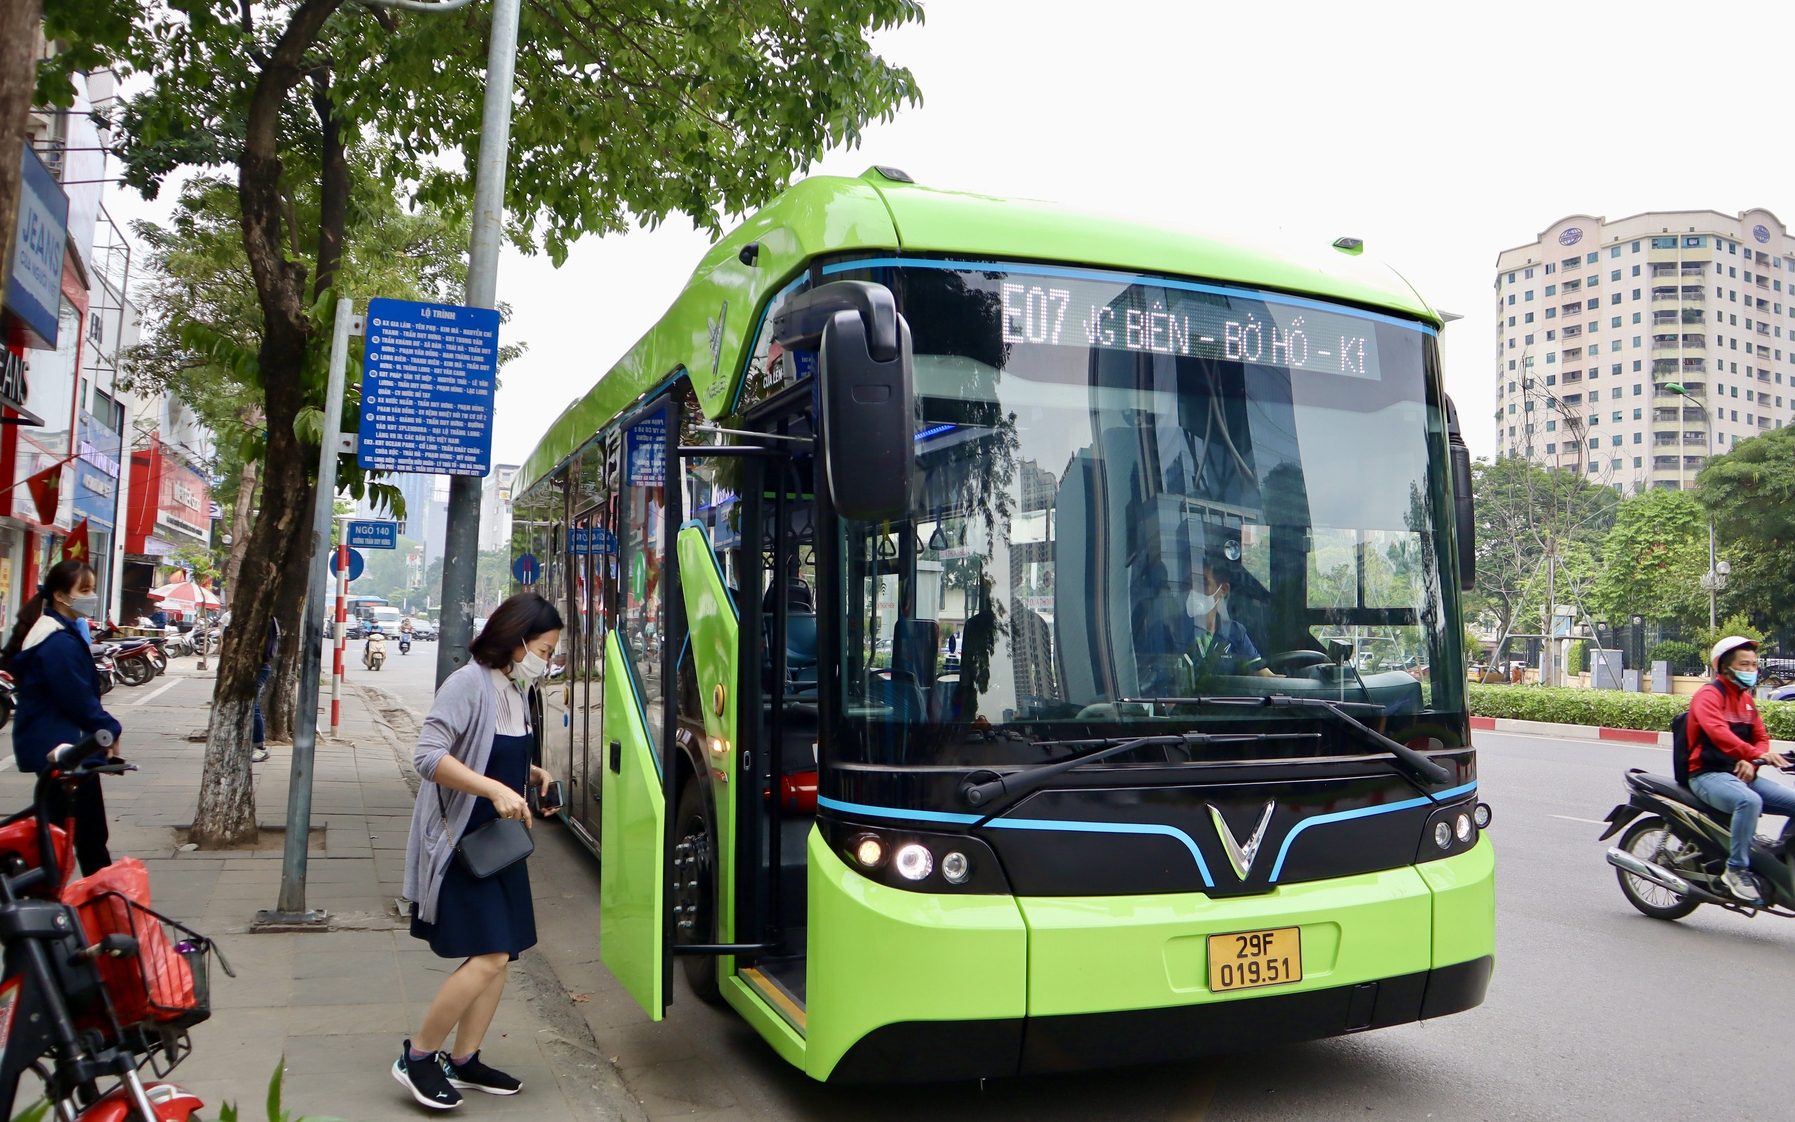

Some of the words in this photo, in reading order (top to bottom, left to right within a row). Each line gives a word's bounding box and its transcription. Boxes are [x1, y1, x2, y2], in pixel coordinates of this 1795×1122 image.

[22, 207, 60, 276] JEANS
[420, 308, 431, 318] LỘ
[433, 310, 456, 320] TRÌNH
[1003, 282, 1070, 345] E07
[1127, 301, 1189, 354] BIÊN
[355, 524, 374, 535] NGÕ
[376, 527, 390, 536] 140
[1236, 933, 1274, 959] 29F
[1221, 957, 1290, 987] 019.51
